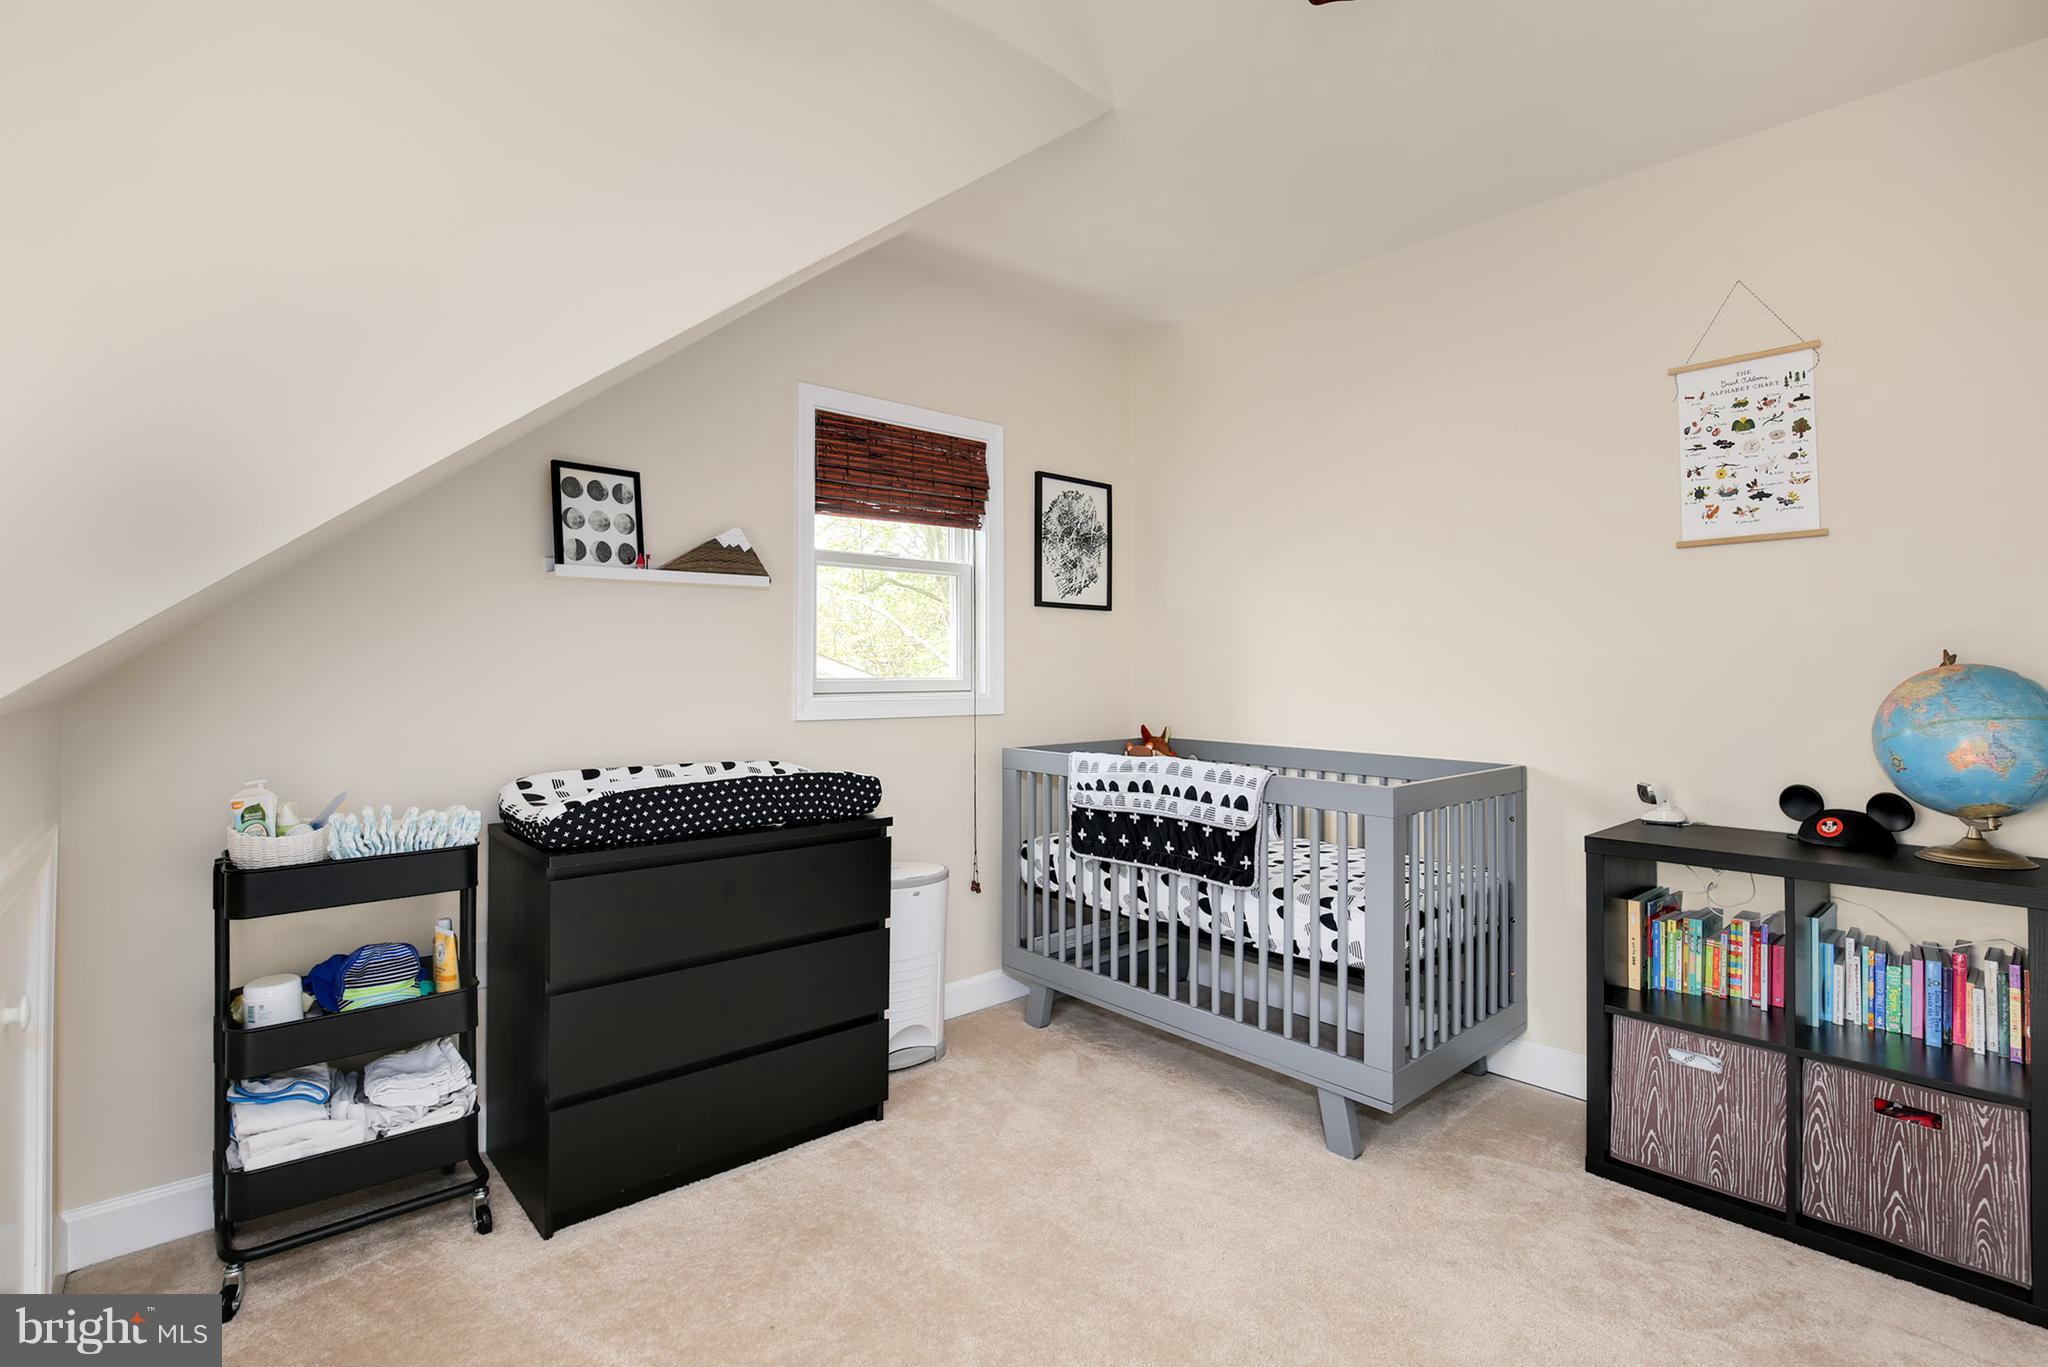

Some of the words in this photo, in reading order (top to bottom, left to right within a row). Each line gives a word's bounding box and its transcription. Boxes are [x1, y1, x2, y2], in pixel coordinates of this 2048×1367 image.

[1736, 369, 1752, 377] THE
[1710, 385, 1750, 397] ALPHABET
[1752, 380, 1779, 390] CHART
